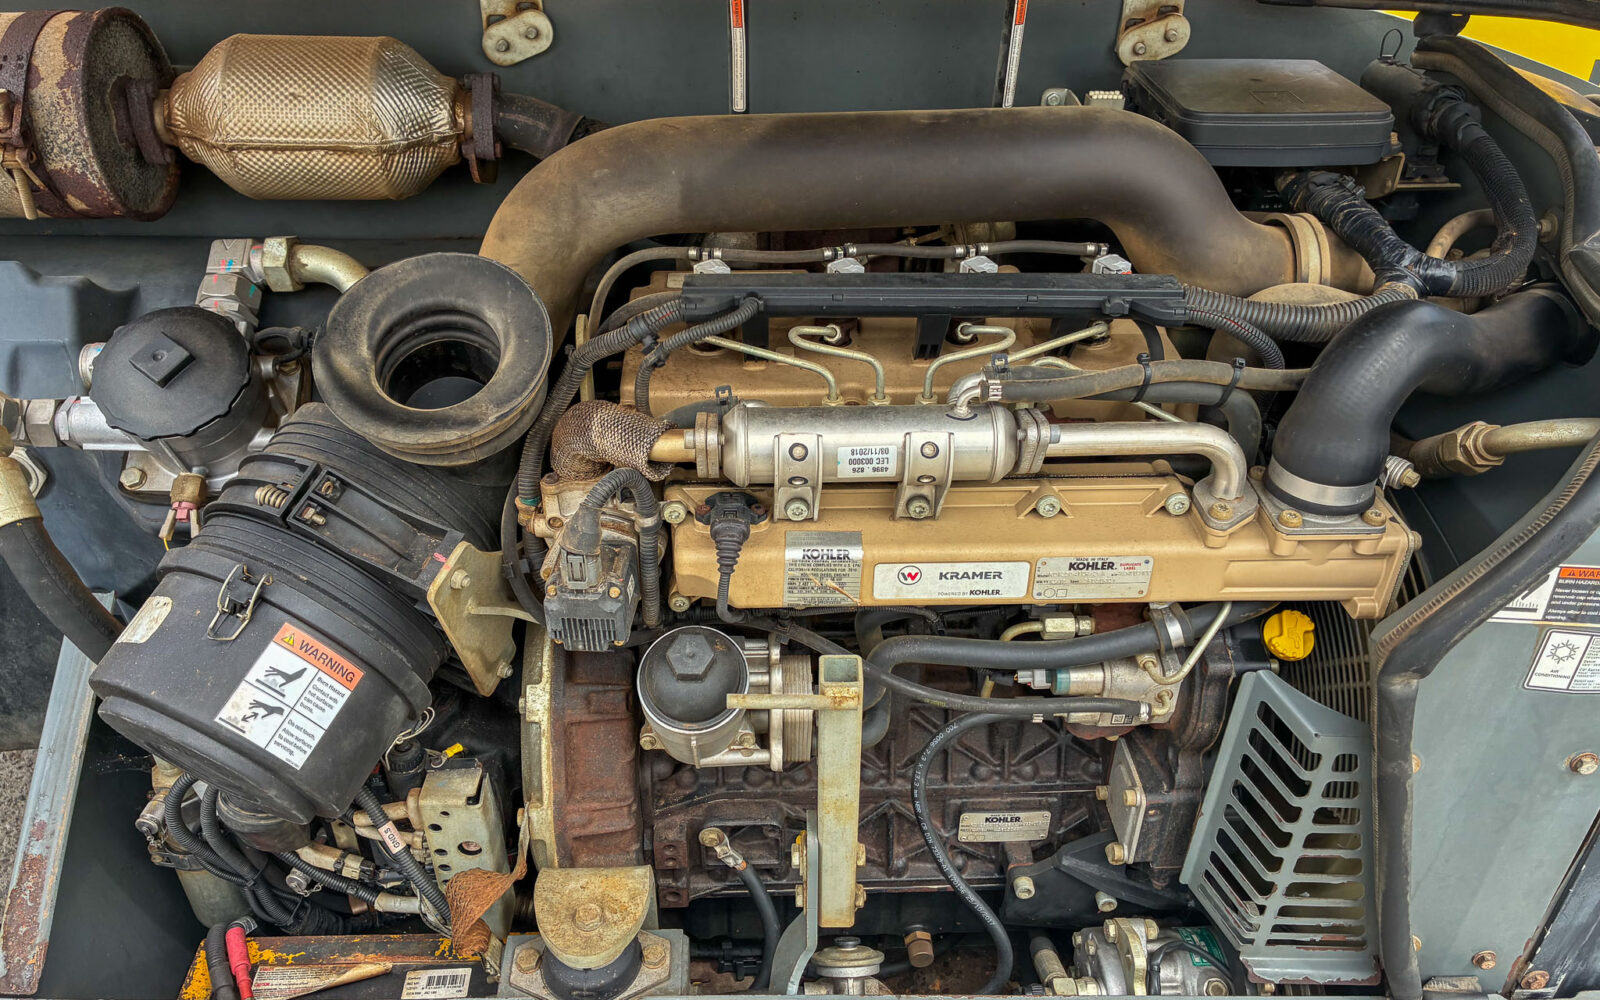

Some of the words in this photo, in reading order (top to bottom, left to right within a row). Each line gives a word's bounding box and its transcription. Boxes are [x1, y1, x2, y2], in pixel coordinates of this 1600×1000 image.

[802, 548, 850, 560] KOHLER
[1069, 562, 1115, 570] KOHLER
[938, 571, 1003, 580] KRAMER
[299, 640, 355, 683] WARNING
[317, 677, 328, 687] Burn
[329, 683, 345, 698] Hazard
[312, 684, 329, 698] Contact
[329, 696, 338, 704] with
[316, 694, 333, 710] surfaces
[282, 728, 294, 738] Allow
[295, 724, 303, 732] not
[946, 722, 958, 733] 700
[283, 737, 294, 746] cool
[293, 742, 307, 755] before
[925, 832, 933, 844] DIN
